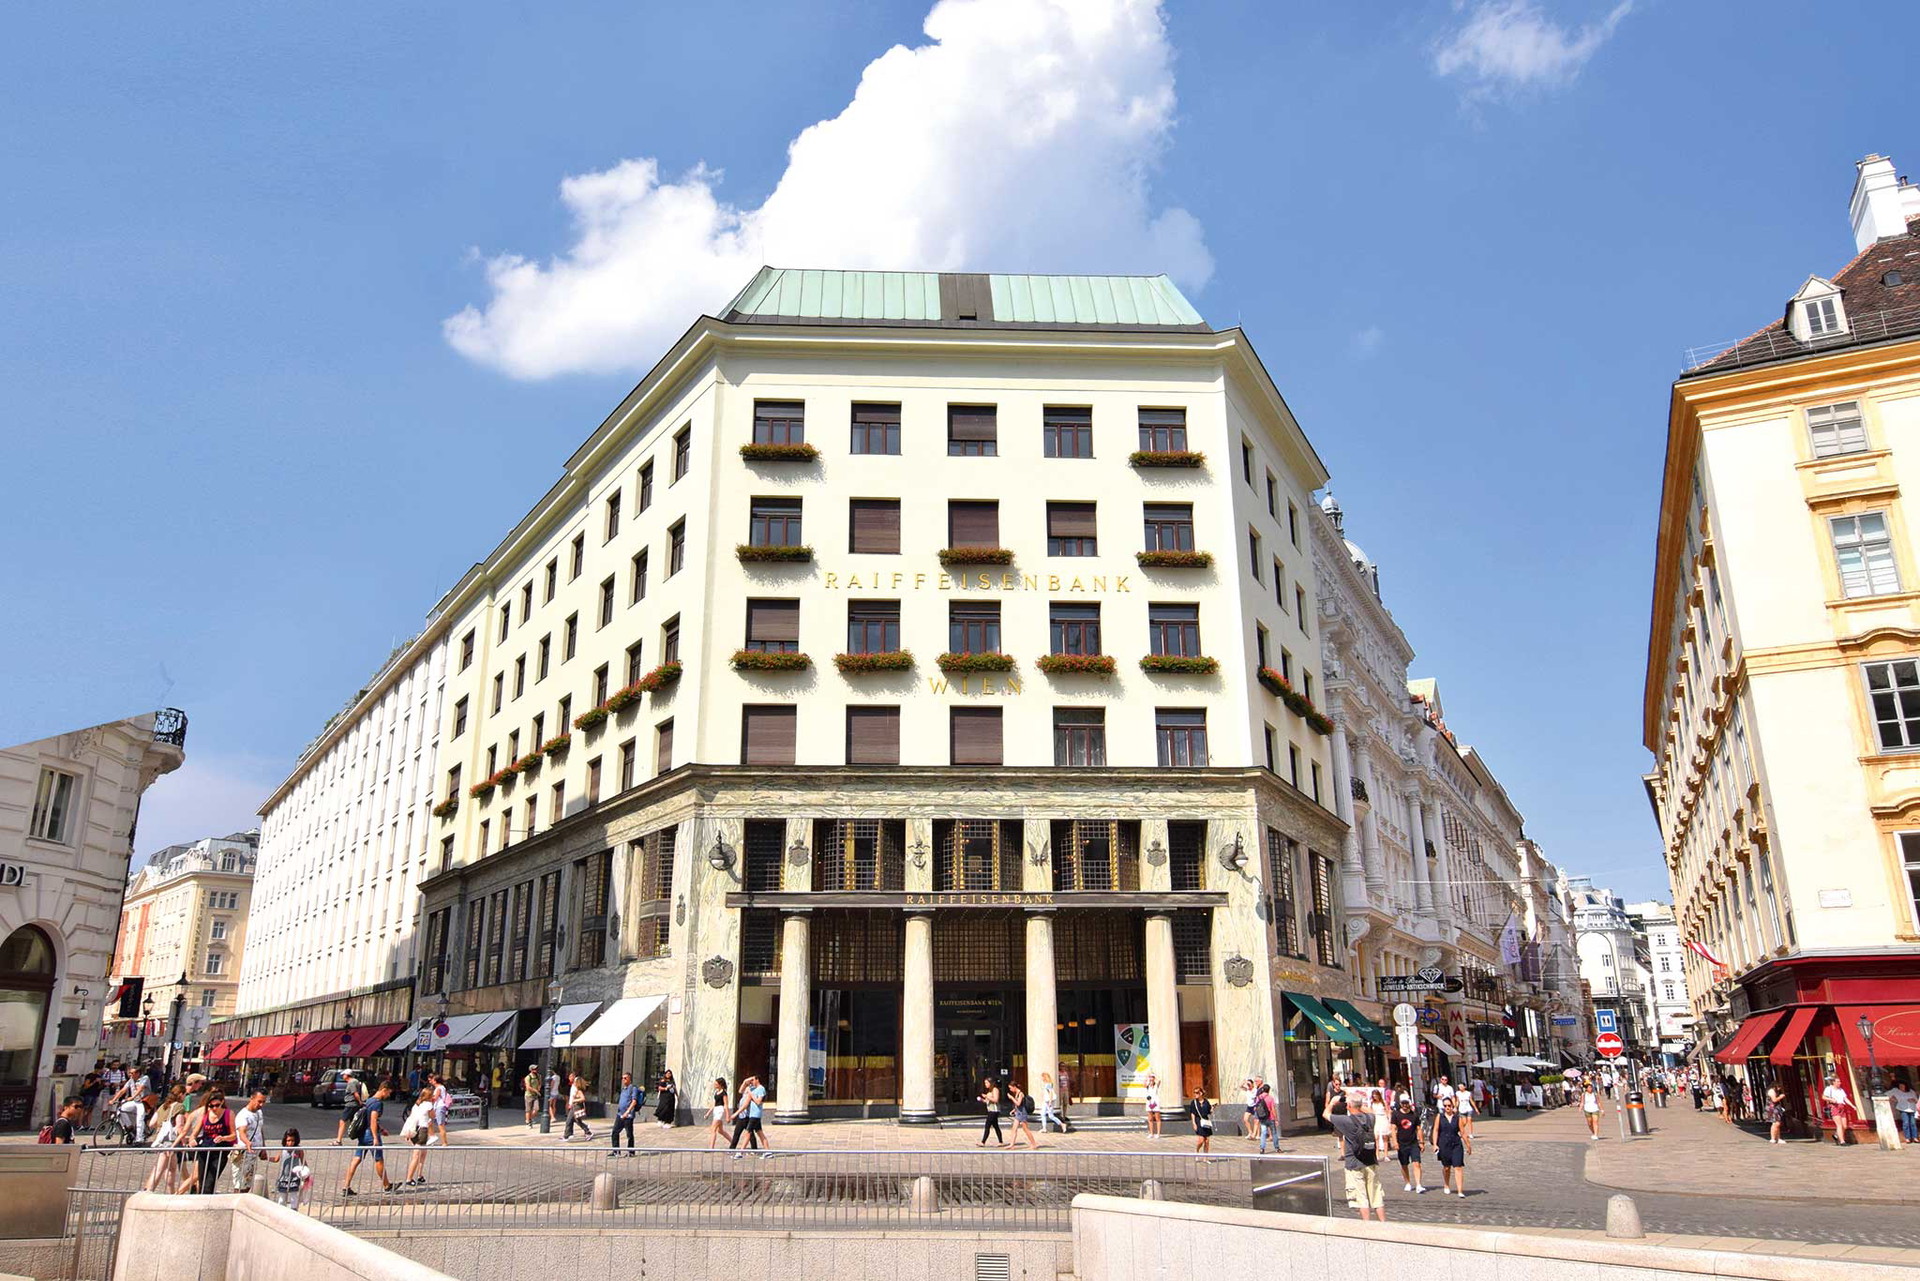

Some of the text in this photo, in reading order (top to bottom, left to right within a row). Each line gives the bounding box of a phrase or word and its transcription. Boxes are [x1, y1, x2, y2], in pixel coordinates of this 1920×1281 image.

[824, 572, 1131, 592] RAIFFEISENBANK
[928, 677, 1022, 695] WIEN
[906, 894, 1054, 905] RAIFFEISENBANK
